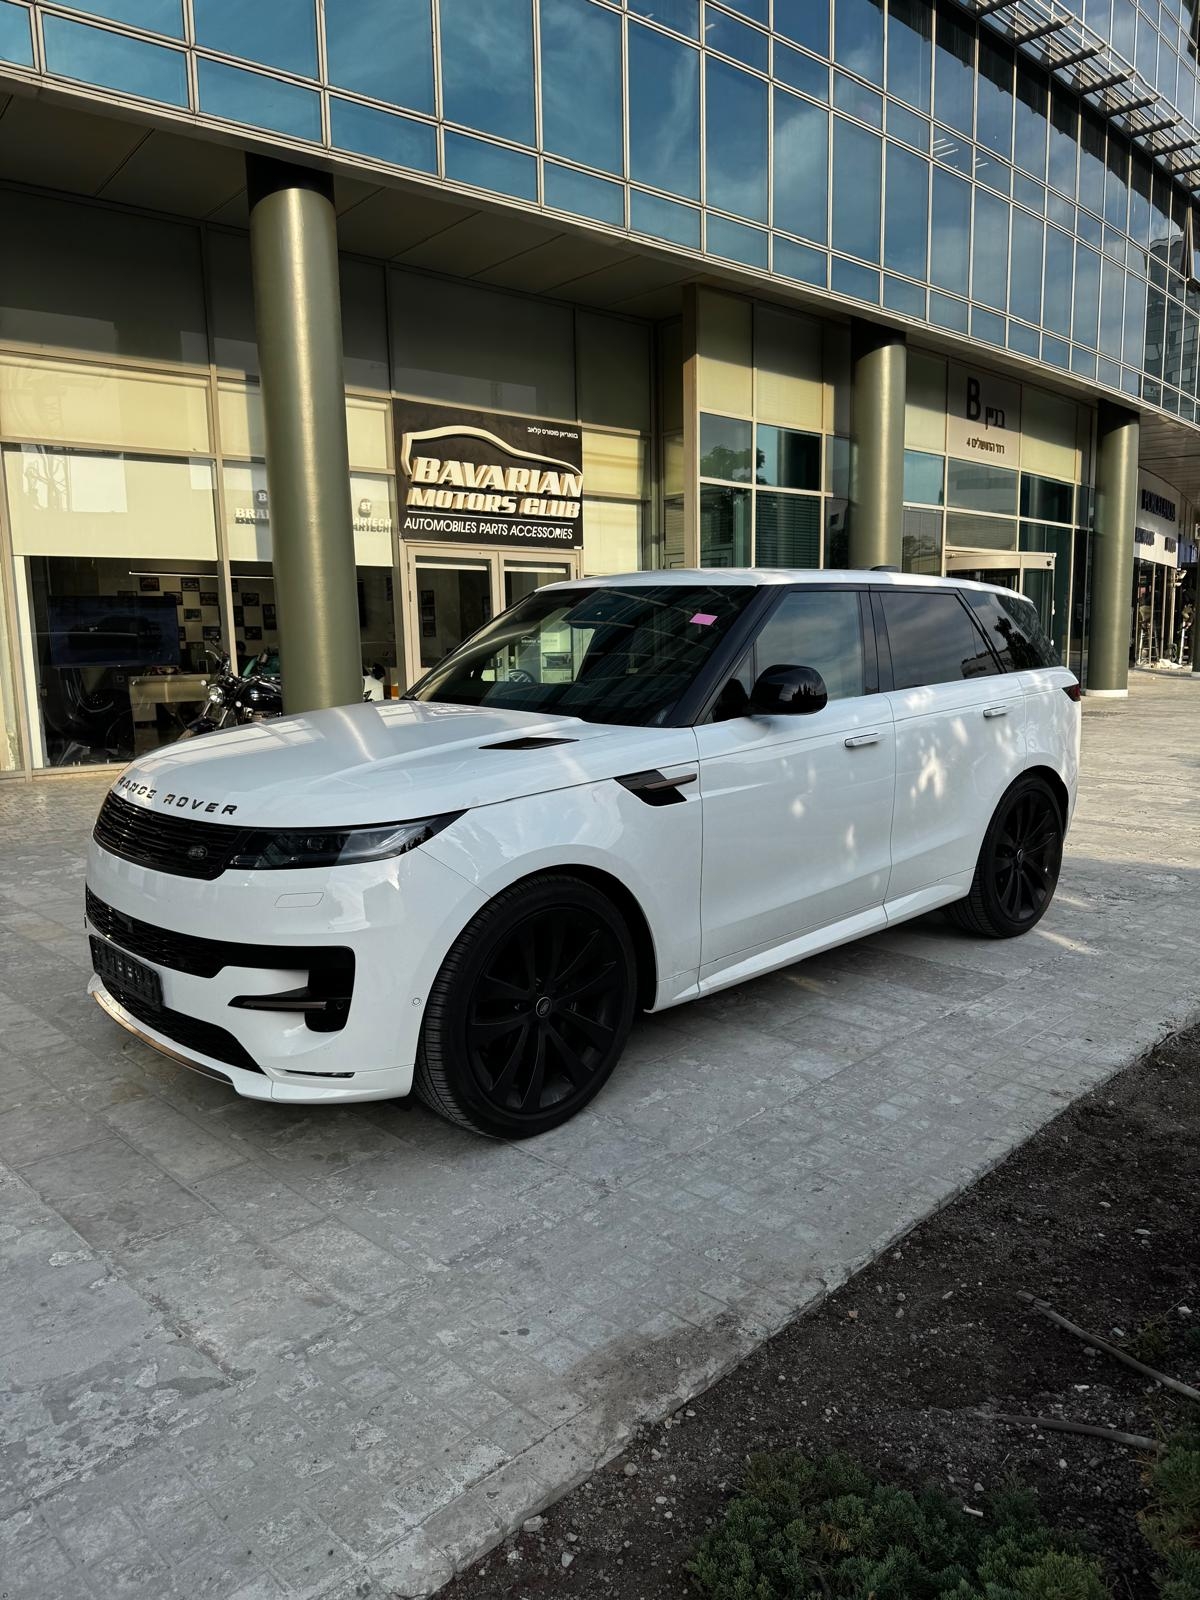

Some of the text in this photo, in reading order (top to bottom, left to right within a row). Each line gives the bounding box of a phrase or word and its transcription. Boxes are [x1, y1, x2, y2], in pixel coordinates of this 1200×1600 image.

[966, 377, 1005, 430] בניין B
[541, 428, 559, 436] מוטורס
[966, 437, 971, 447] 4
[411, 456, 583, 498] BAVARIAN
[235, 508, 270, 519] BRA
[406, 487, 581, 519] MOTORS CLUB
[352, 517, 392, 528] ARTECH
[404, 517, 573, 540] AUTOMOBILES PARTS ACCESSORIES
[118, 776, 238, 815] RANGE ROVER
